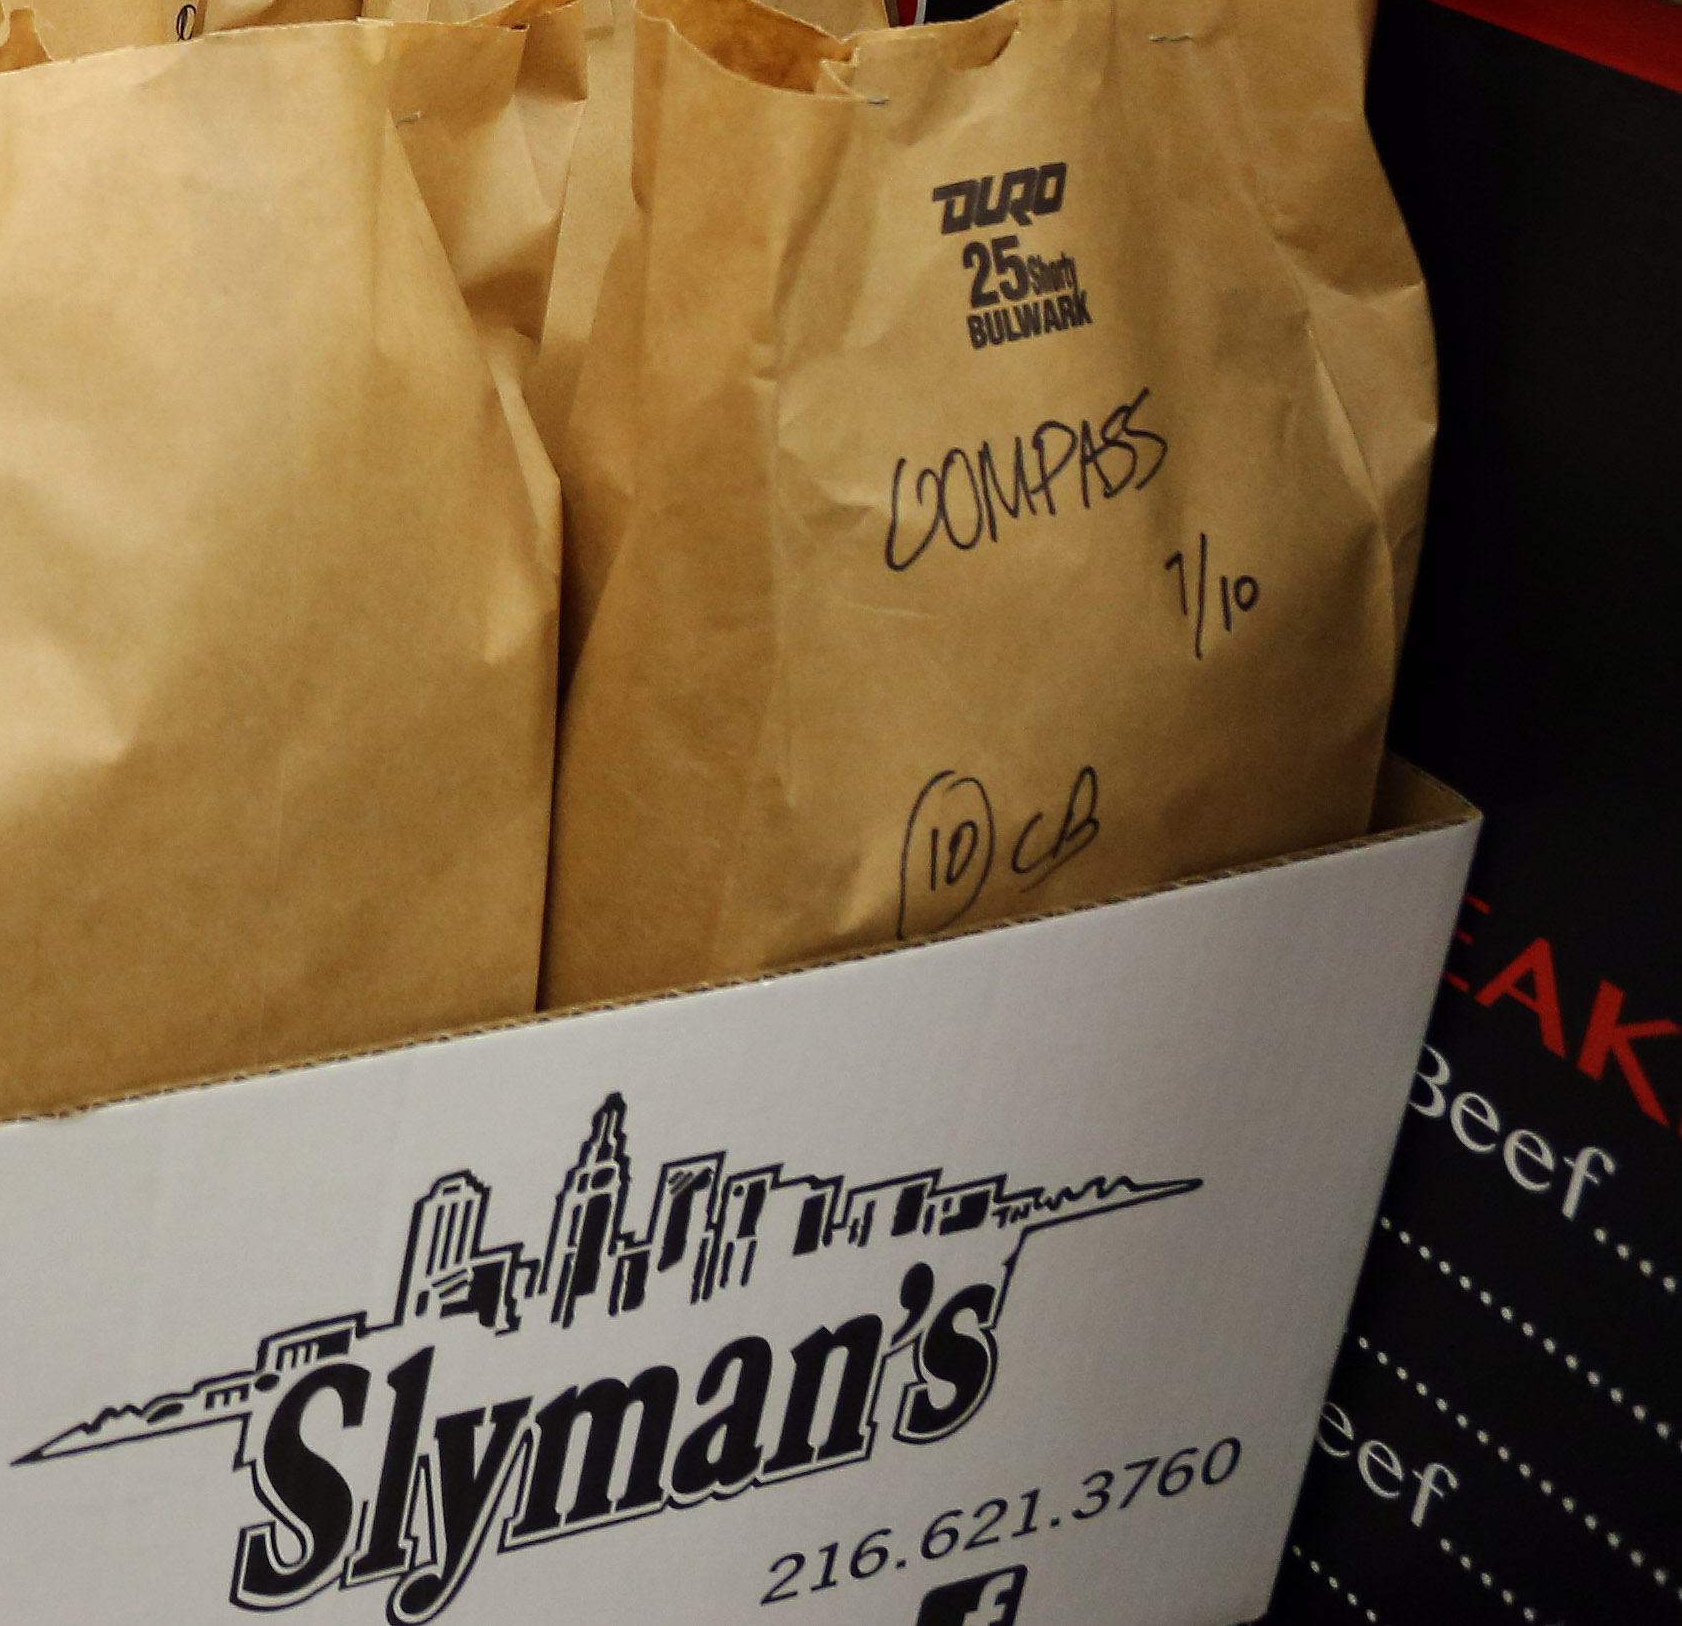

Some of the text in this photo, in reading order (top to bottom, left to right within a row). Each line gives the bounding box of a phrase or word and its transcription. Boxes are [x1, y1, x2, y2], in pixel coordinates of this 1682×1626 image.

[932, 162, 1068, 235] DURO
[962, 234, 1031, 308] 25
[967, 288, 1094, 350] BULWARK
[885, 386, 1168, 572] COMPASS
[230, 1261, 999, 1626] Slyman's
[1314, 1400, 1461, 1528] eef
[759, 1437, 1243, 1607] 216.621.3760
